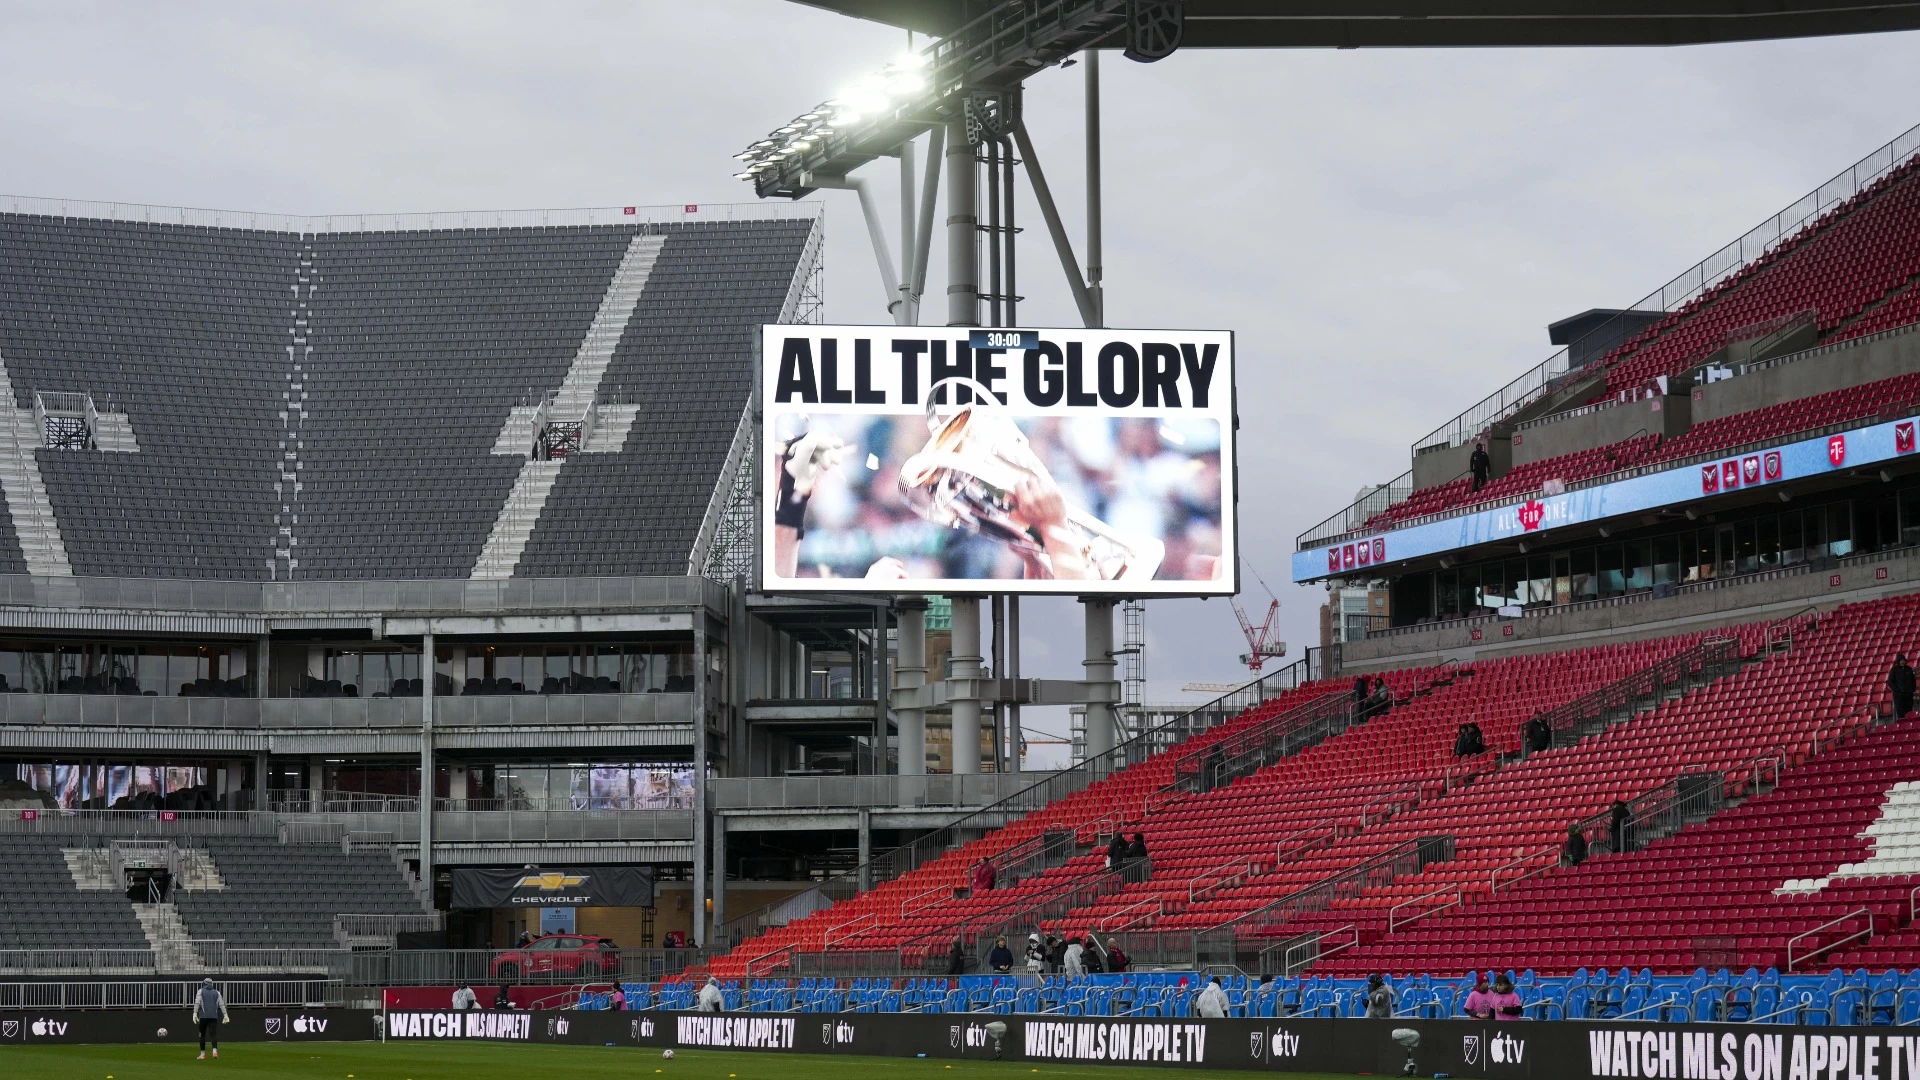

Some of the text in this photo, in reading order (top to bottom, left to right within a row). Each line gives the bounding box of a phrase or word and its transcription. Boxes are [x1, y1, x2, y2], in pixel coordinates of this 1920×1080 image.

[987, 332, 1021, 347] 30:00
[775, 338, 1220, 409] ALL THE GLORY
[1499, 501, 1567, 531] ALL FOR ONE
[47, 1019, 68, 1036] tv
[308, 1016, 328, 1033] tv
[389, 1013, 462, 1037] WATCH
[486, 1013, 496, 1038] ON
[497, 1014, 519, 1039] APPLE
[521, 1014, 530, 1039] TV
[678, 1016, 796, 1048] WATCH MLS ON APPLE TV
[844, 1022, 855, 1043] tv
[975, 1024, 987, 1047] tv
[1025, 1022, 1206, 1063] WATCH MLS ON APPLE TV
[1283, 1030, 1300, 1057] tv
[1504, 1034, 1525, 1064] tv
[1589, 1031, 1677, 1079] WATCH
[1682, 1032, 1738, 1080] MLS
[1744, 1033, 1782, 1080] ON
[1789, 1034, 1880, 1080] APPLE
